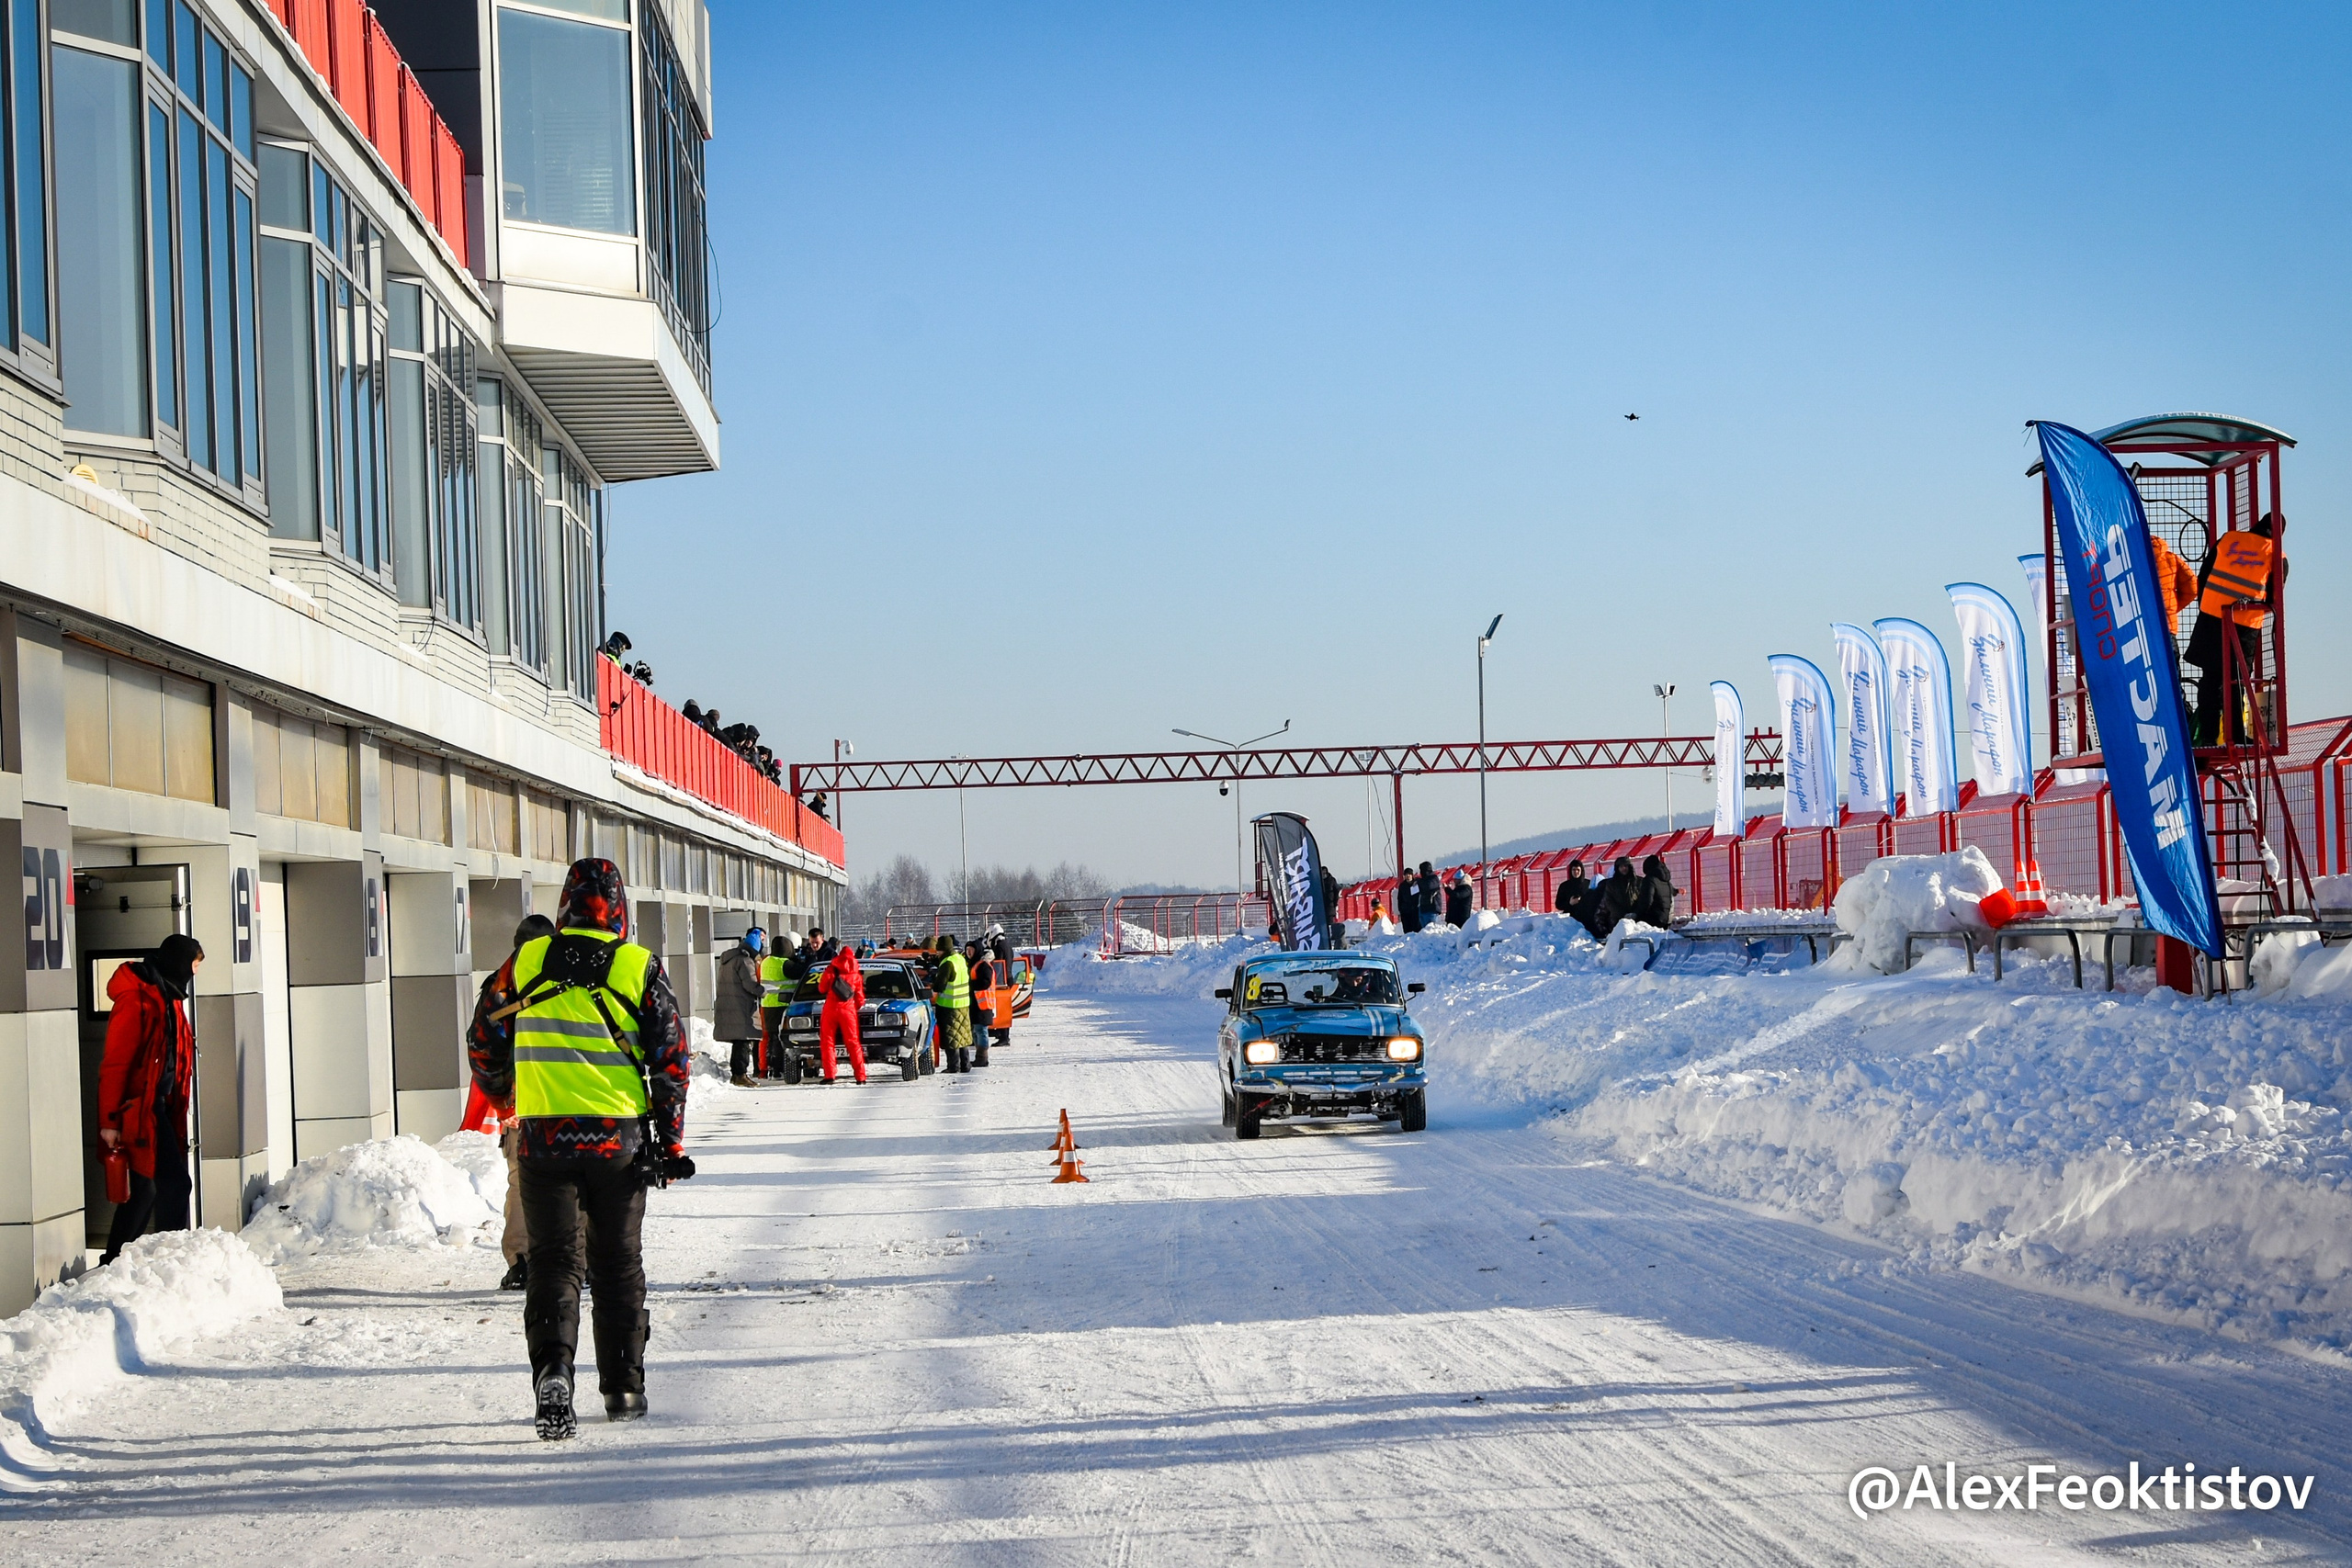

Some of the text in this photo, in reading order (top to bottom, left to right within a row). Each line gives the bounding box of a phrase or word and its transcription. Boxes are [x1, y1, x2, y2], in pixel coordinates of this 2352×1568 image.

[1785, 697, 1811, 813] Зимний Марафон
[1849, 731, 1871, 797] Марафон
[1972, 702, 2003, 778] Марафон
[23, 846, 63, 970] 20
[1247, 976, 1262, 1000] 8
